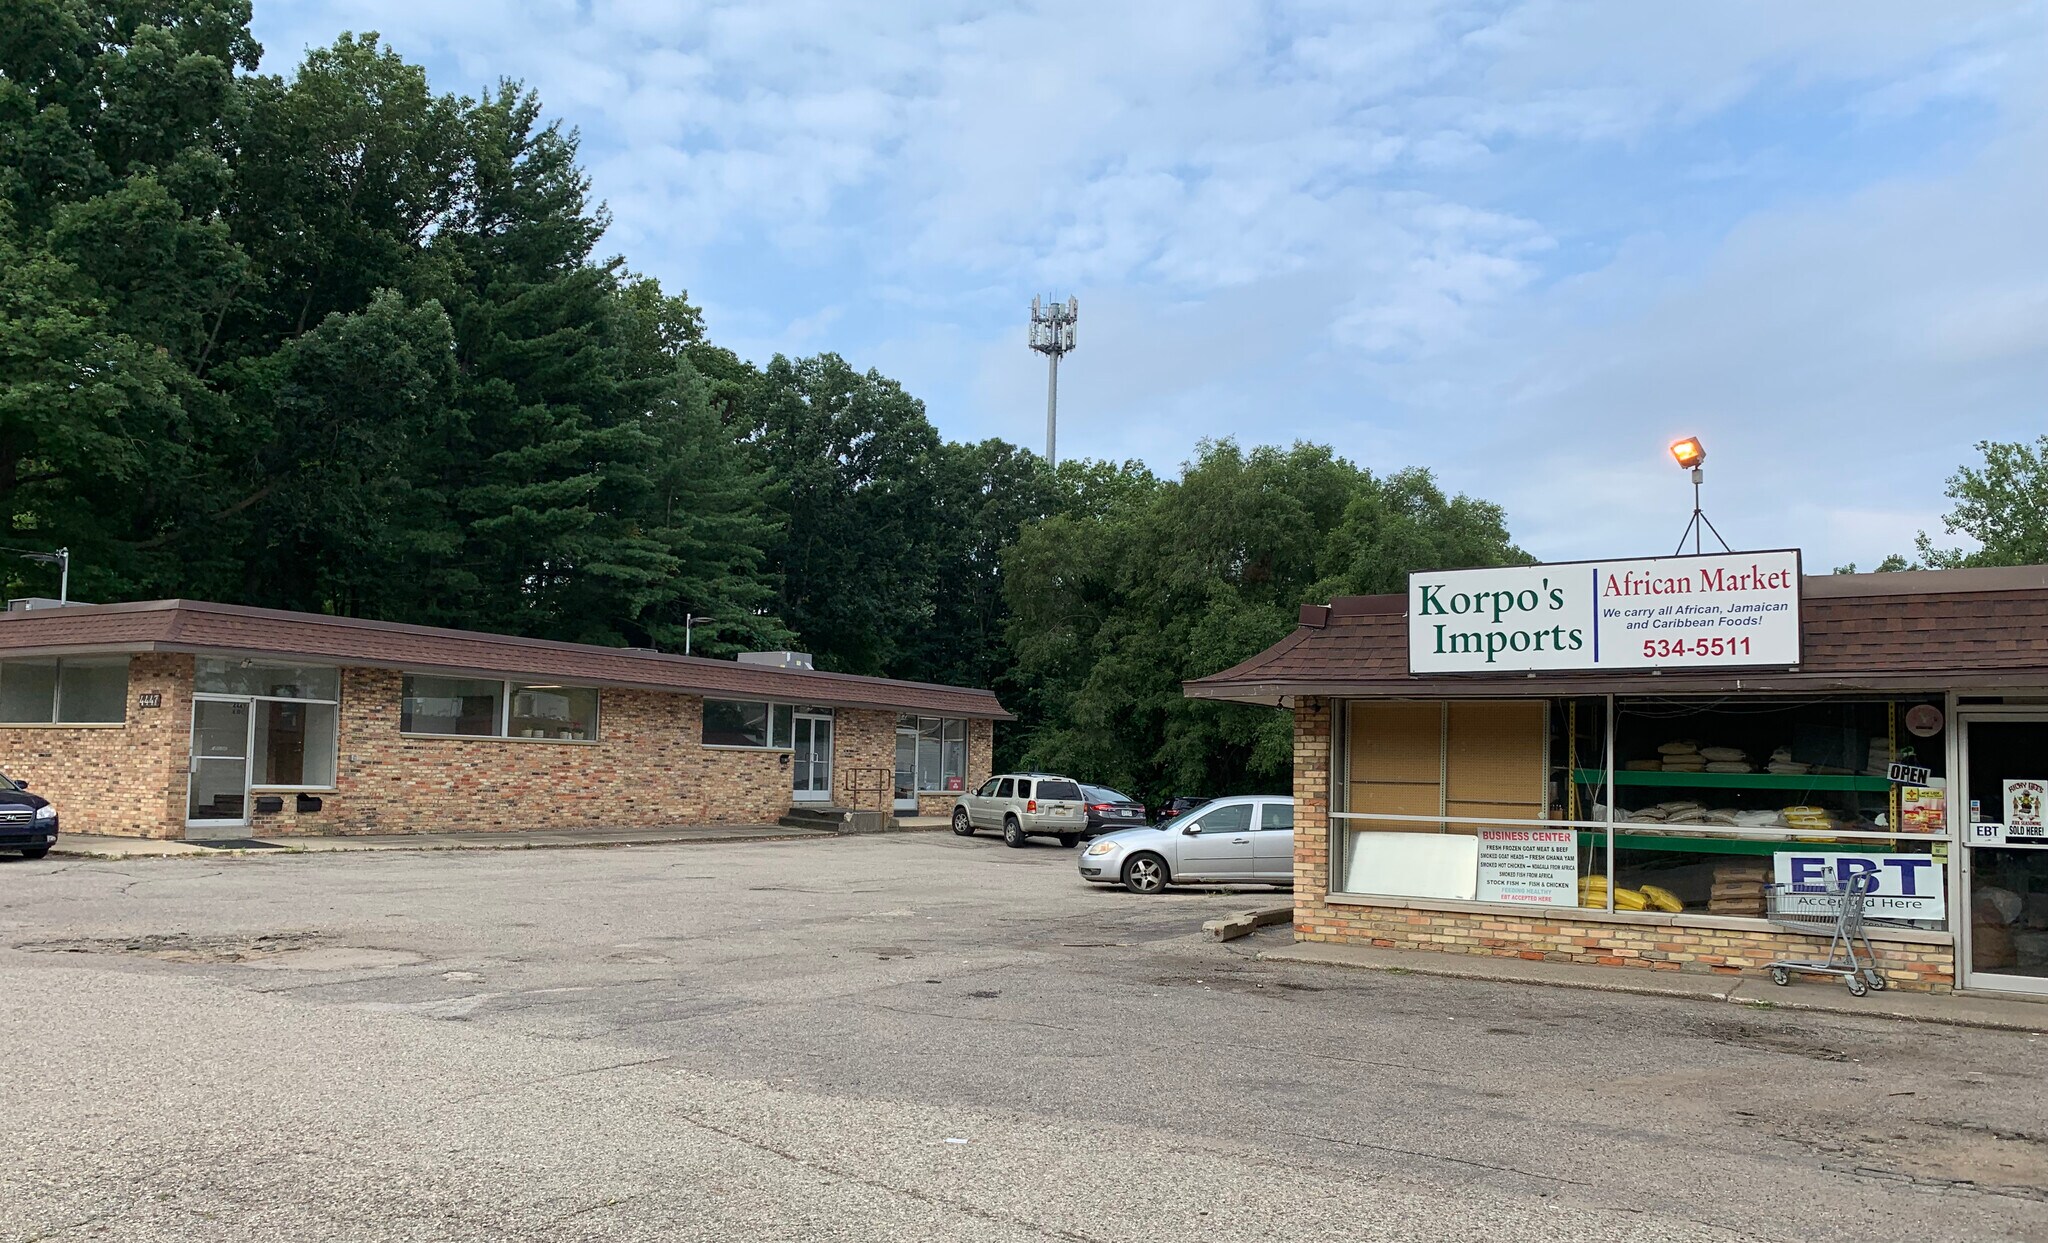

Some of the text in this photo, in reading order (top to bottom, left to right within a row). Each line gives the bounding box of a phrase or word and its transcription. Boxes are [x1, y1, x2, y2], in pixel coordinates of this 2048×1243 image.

[1603, 565, 1791, 596] African Market
[1419, 578, 1564, 623] Korpo's
[1603, 602, 1788, 618] We carry all African, Jamaican
[1627, 616, 1762, 629] and Caribbean Foods!
[1433, 624, 1583, 663] Imports
[1643, 637, 1750, 657] 534-5511
[140, 695, 159, 706] 4447
[1891, 765, 1927, 784] OPEN
[1483, 831, 1571, 842] BUSINESS CENTER
[1977, 826, 1999, 836] EBT
[2009, 826, 2044, 836] SOLD HERE!
[1791, 858, 1931, 895] EBT
[1798, 897, 1874, 909] Accepd
[1882, 898, 1922, 909] Here
